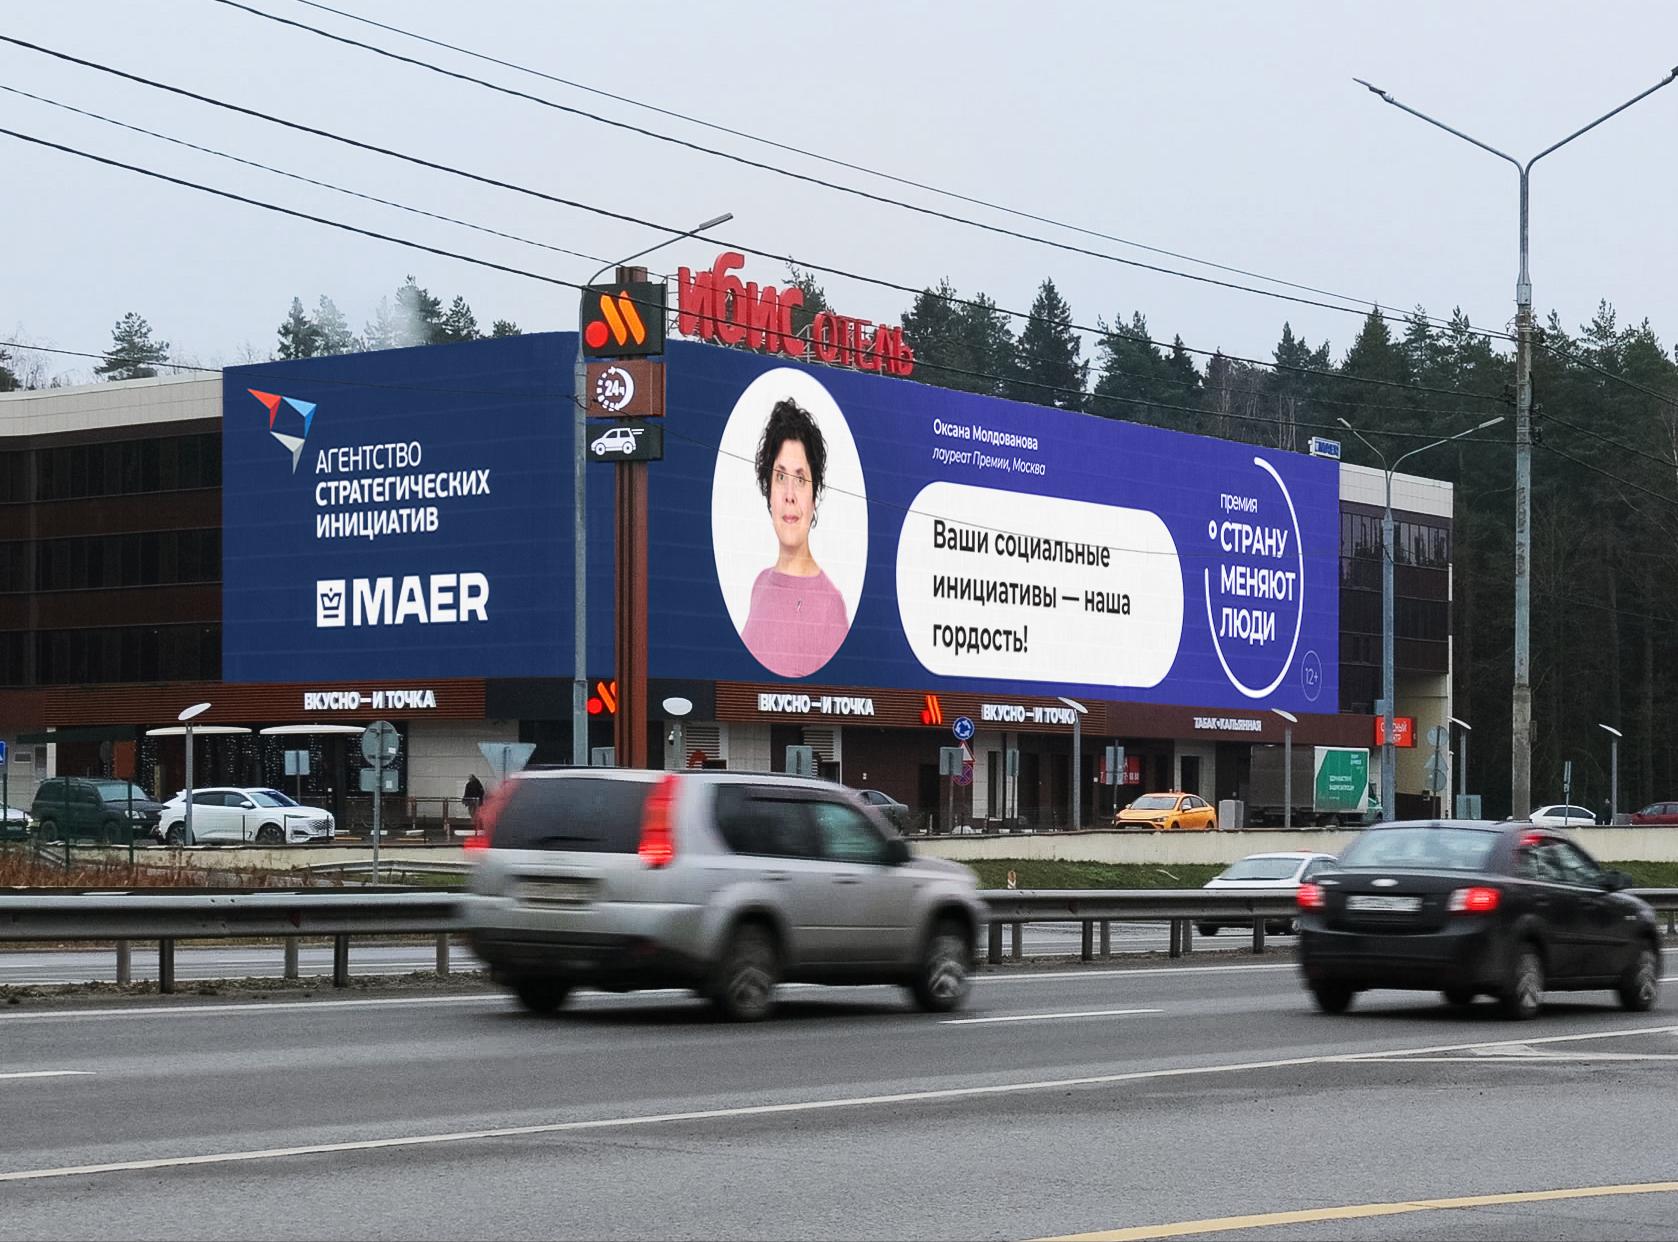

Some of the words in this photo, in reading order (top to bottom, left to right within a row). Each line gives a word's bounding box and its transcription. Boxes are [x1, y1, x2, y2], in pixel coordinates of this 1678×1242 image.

[933, 418, 970, 440] Оксана
[972, 425, 1038, 450] Молдованова
[315, 441, 422, 474] АГЕНТСТВО
[932, 447, 972, 465] лауреат
[972, 450, 1011, 473] Премии,
[1012, 457, 1046, 476] Москва
[315, 469, 491, 506] СТРАТЕГИЧЕСКИХ
[1220, 493, 1258, 514] премия
[316, 506, 439, 541] ИНИЦИАТИВ
[1220, 520, 1288, 559] СТРАНУ
[933, 519, 989, 554] Ваши
[994, 533, 1111, 568] социальные
[353, 572, 490, 626] MAER
[933, 574, 1057, 609] инициативы
[1084, 589, 1131, 616] наша
[1220, 564, 1296, 601] МЕНЯЮТ
[933, 623, 1028, 656] гордость!
[1219, 607, 1276, 646] ЛЮДИ
[1305, 667, 1319, 685] 12+
[386, 690, 437, 709] ТОЧКА
[833, 697, 875, 716] ТОЧКА
